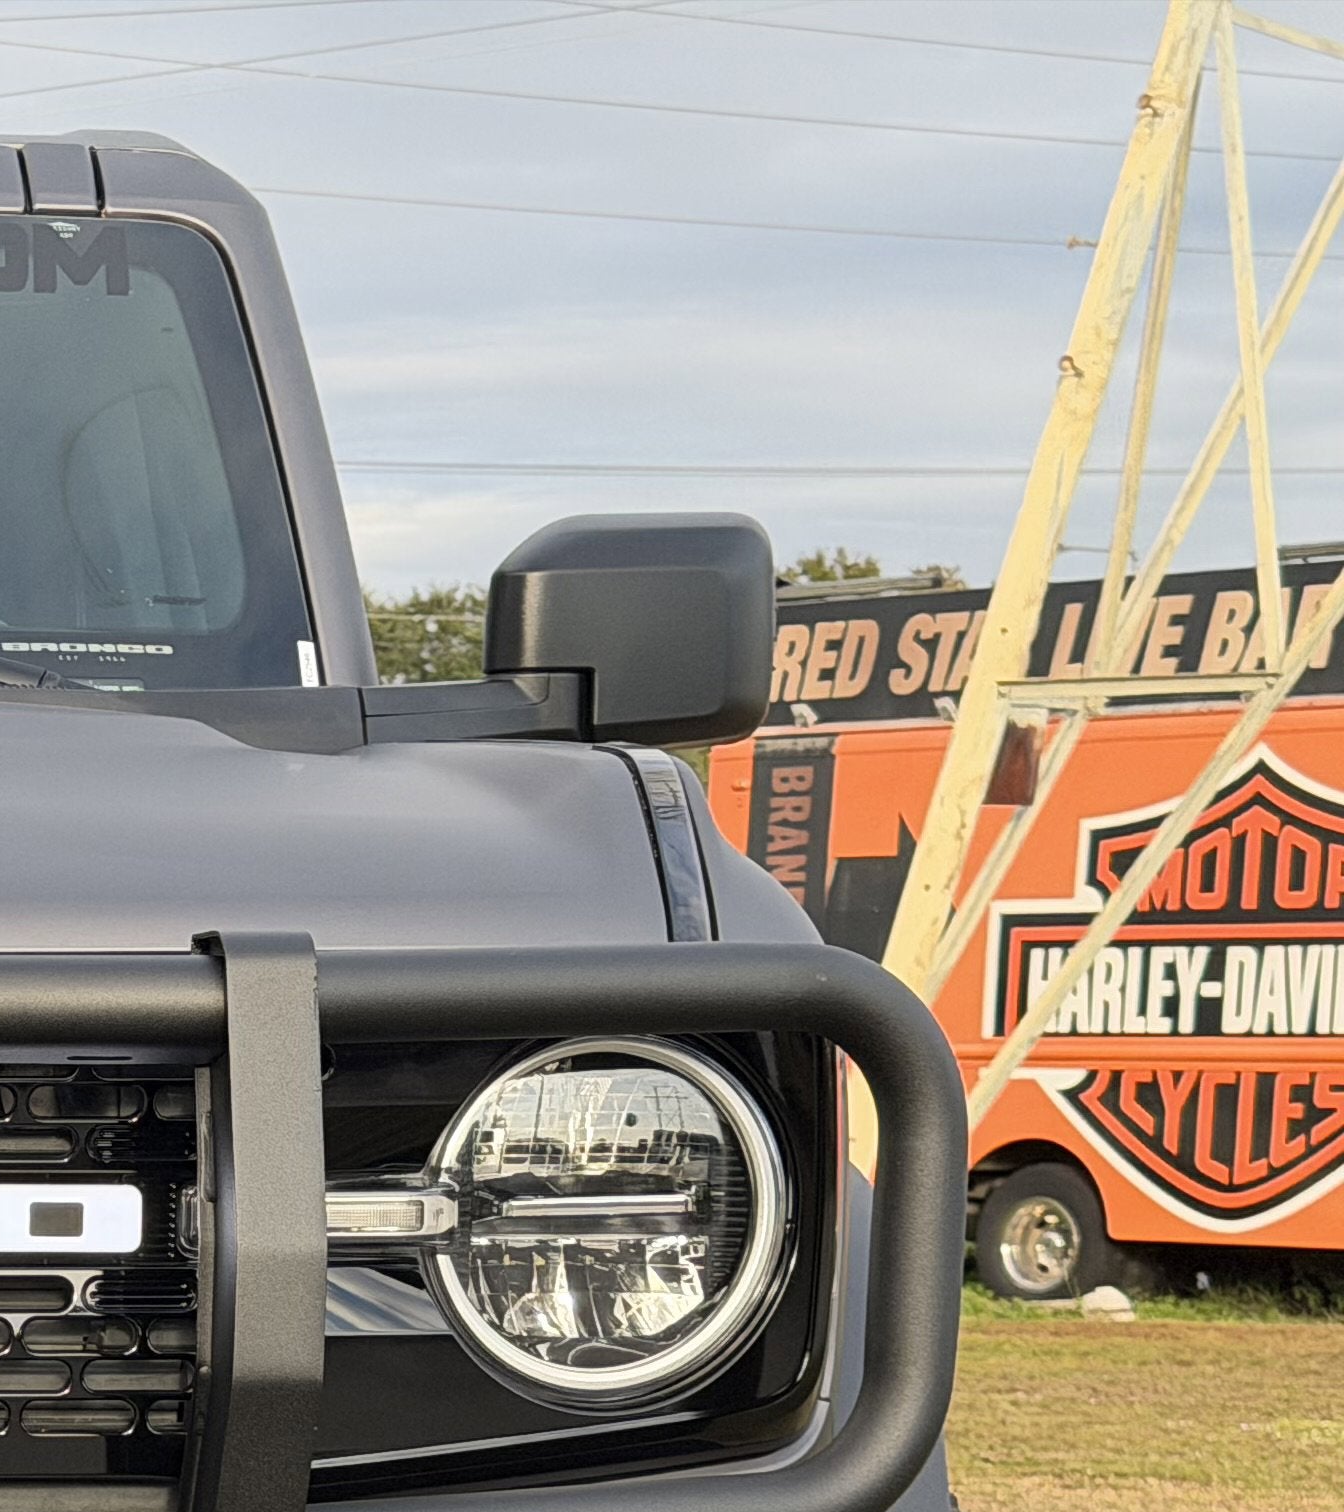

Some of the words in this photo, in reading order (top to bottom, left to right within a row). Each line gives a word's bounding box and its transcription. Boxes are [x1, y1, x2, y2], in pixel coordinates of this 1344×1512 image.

[1, 642, 174, 655] BRONCO
[888, 610, 988, 696] STA
[765, 765, 815, 906] BRAN
[1026, 944, 1344, 1035] HARLEY-DAVI
